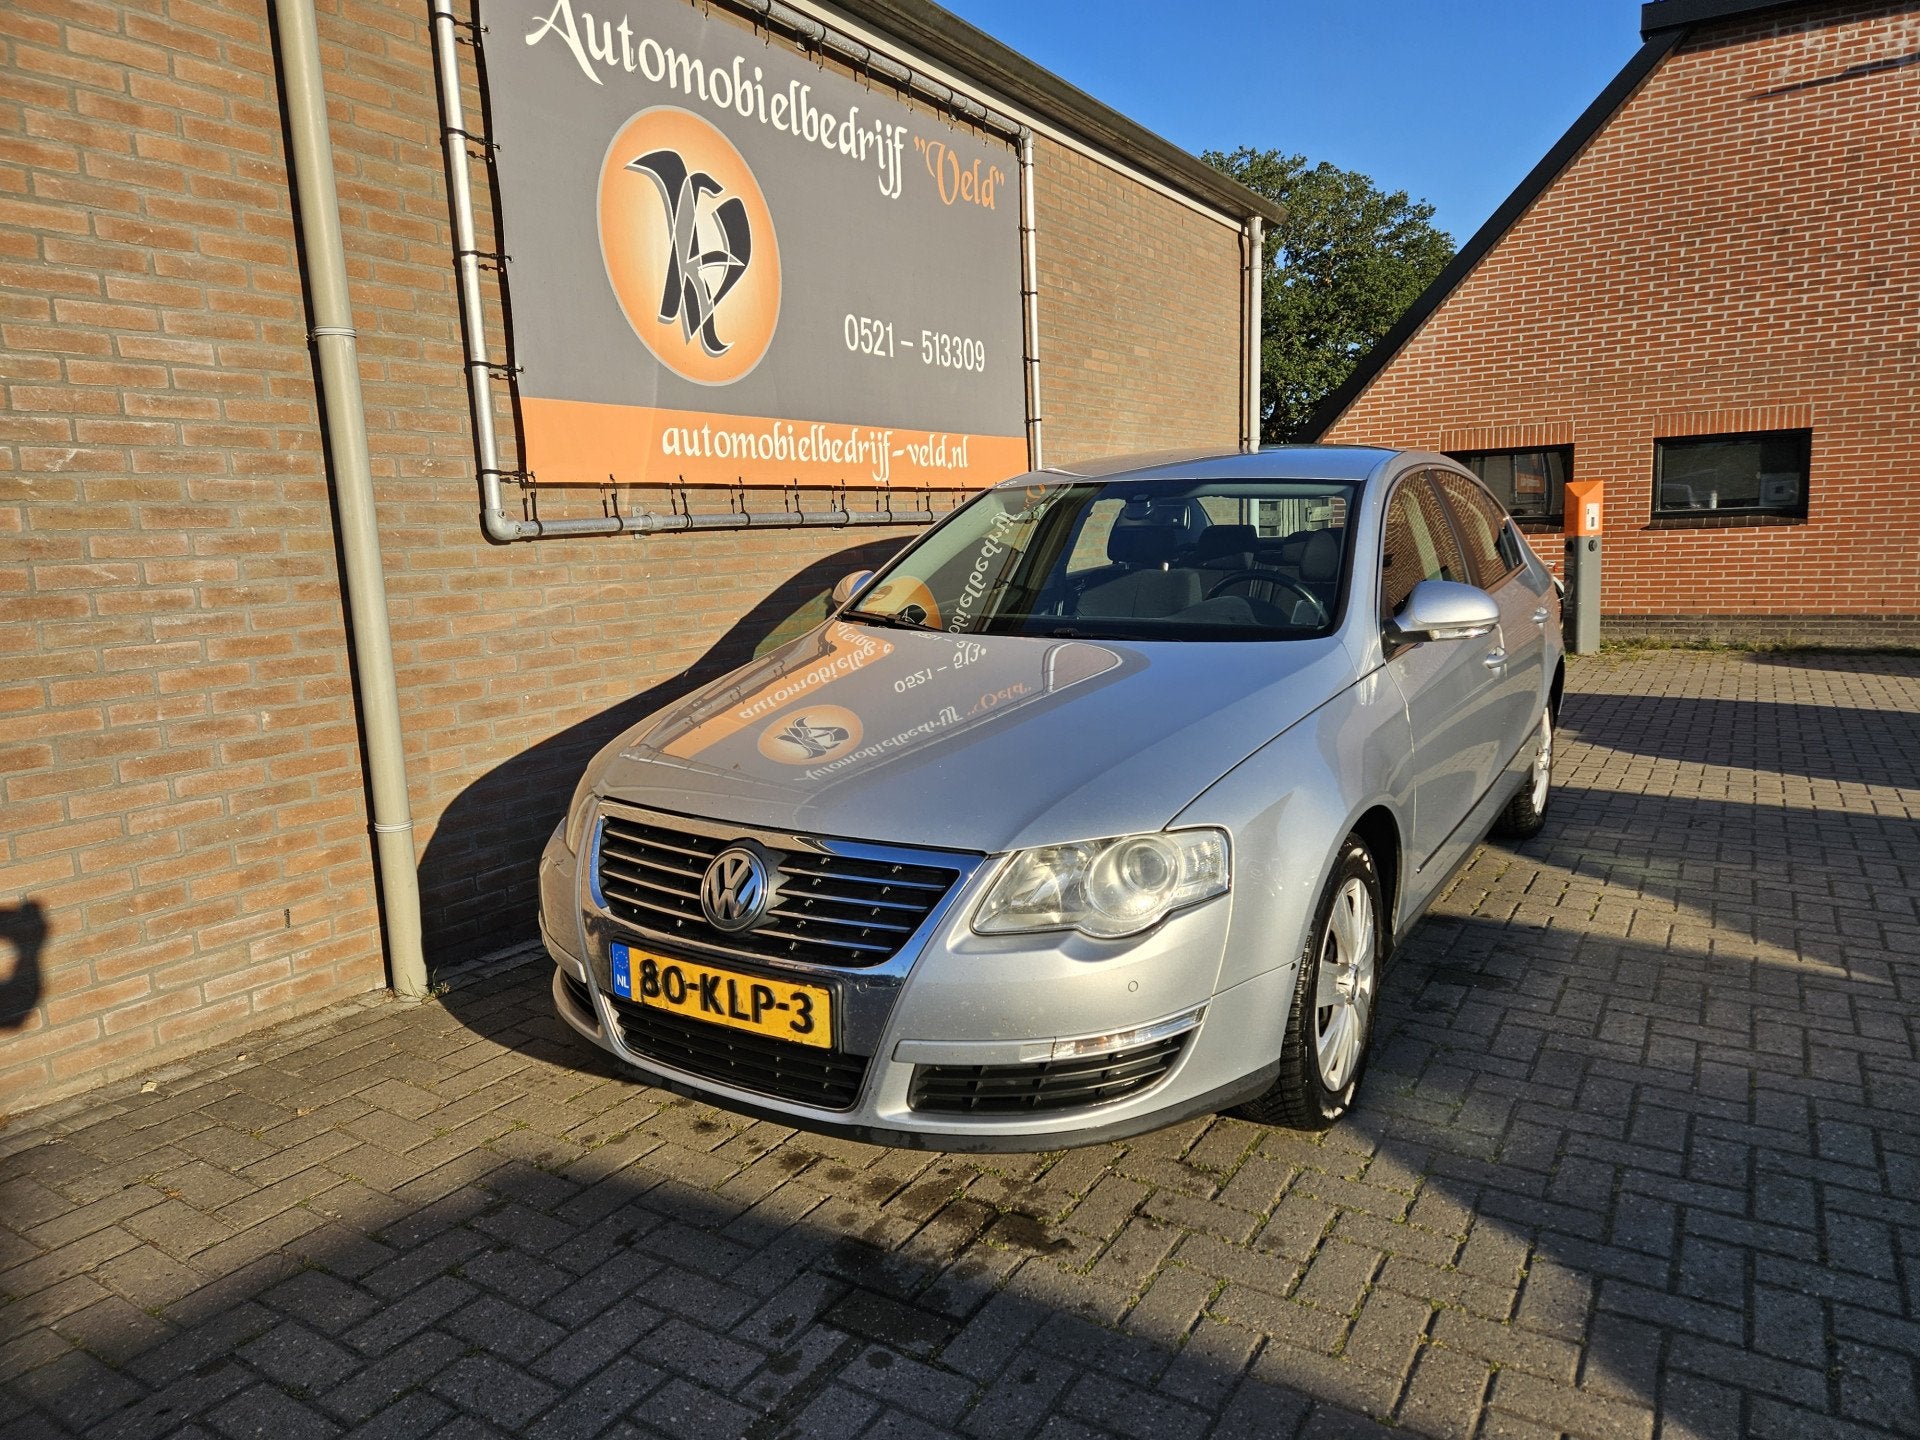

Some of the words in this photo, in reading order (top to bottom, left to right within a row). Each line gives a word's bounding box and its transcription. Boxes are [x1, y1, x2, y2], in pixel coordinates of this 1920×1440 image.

[525, 0, 908, 200] Automobielbedrijf
[844, 313, 895, 358] 0521
[921, 329, 986, 373] 513309
[661, 421, 970, 483] automobielbedrijf-veld.nl
[616, 973, 629, 990] NL
[638, 958, 815, 1035] 80-KLP-3
